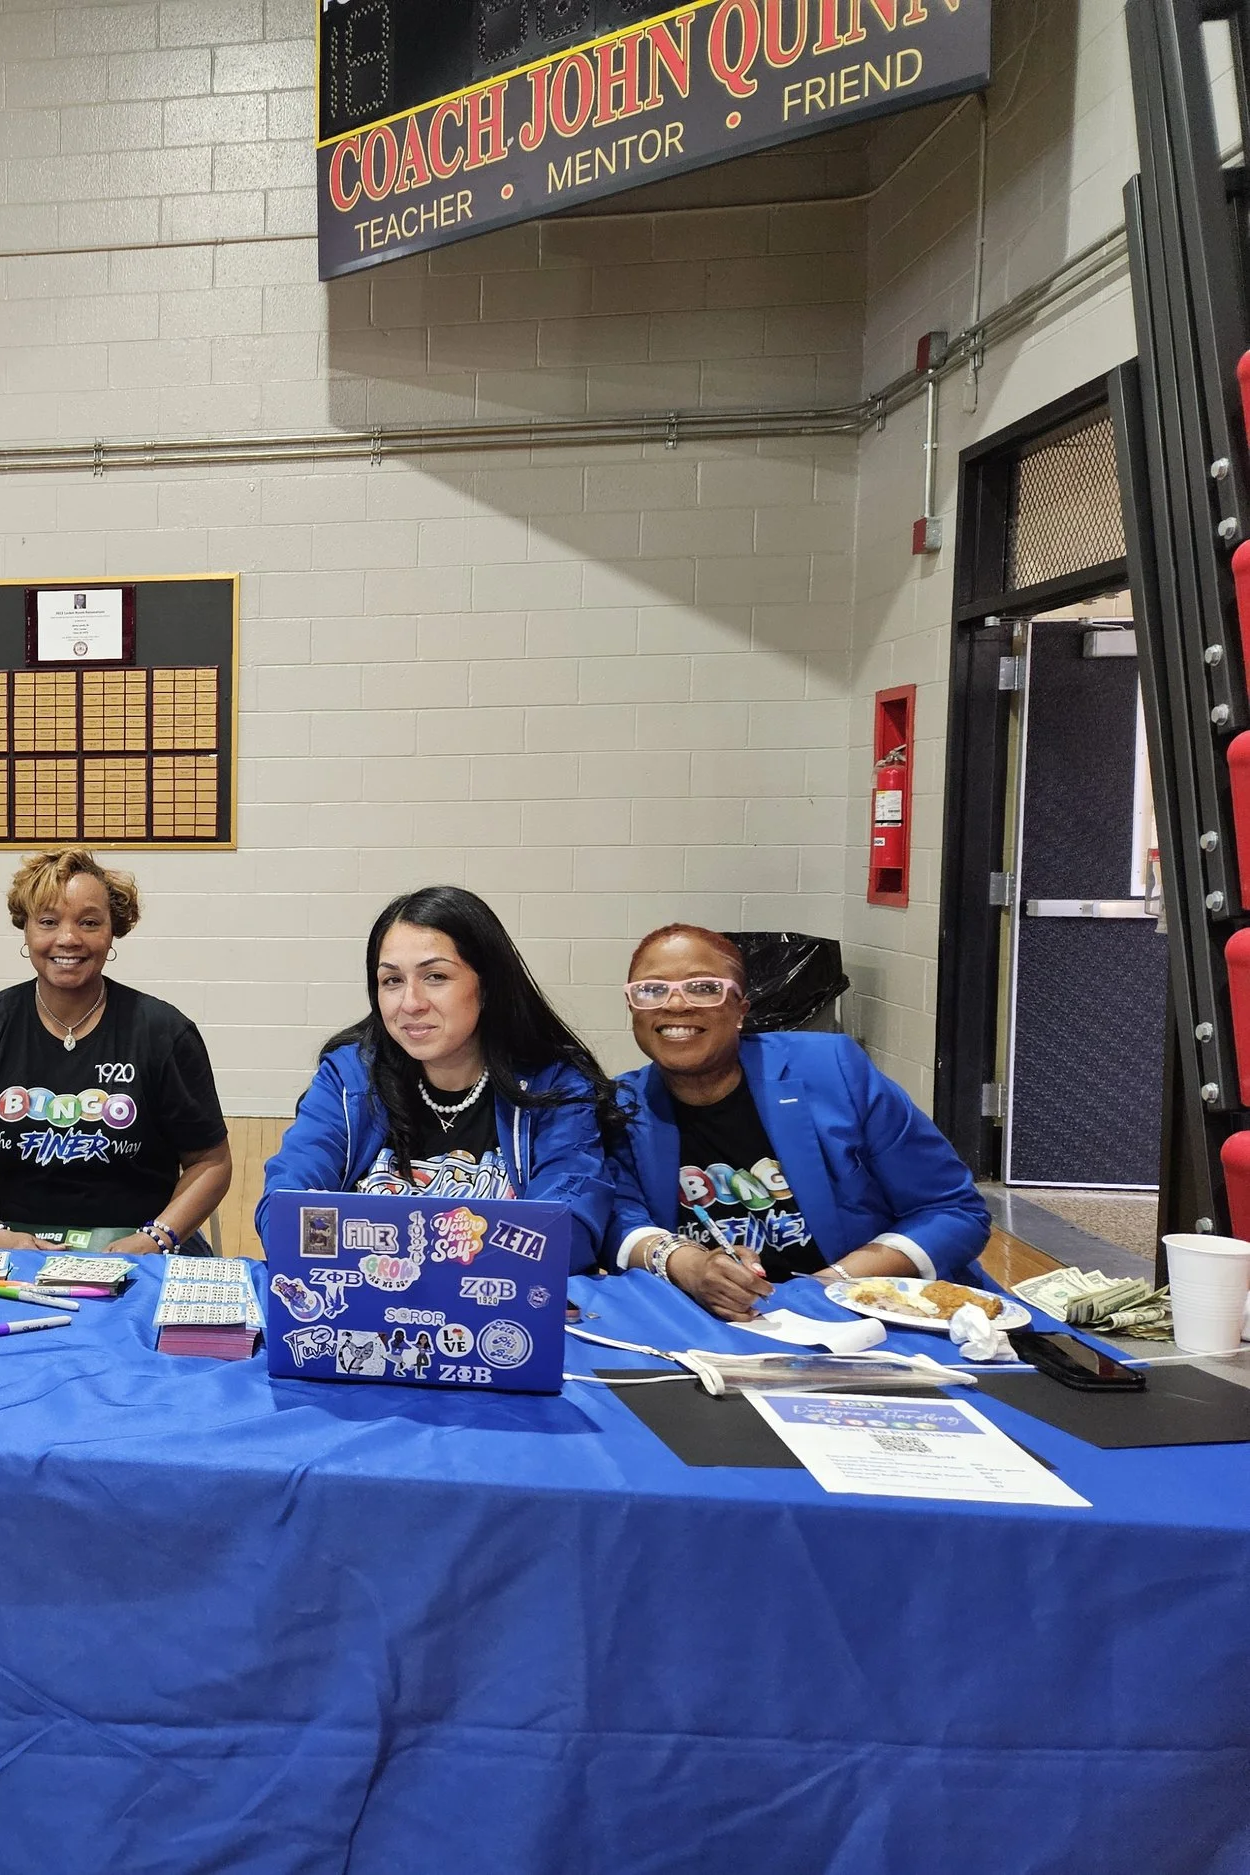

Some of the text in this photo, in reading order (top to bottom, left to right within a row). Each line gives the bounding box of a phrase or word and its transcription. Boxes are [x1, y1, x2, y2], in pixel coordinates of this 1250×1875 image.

[329, 80, 509, 212] COACH
[518, 11, 695, 152] JOHN
[355, 48, 923, 251] TEACHER MENTOR FRIEND
[95, 1062, 136, 1084] 1920
[0, 1089, 134, 1125] BINGO
[17, 1127, 110, 1166] FINER
[111, 1140, 142, 1159] Way
[345, 1221, 396, 1251] FINER
[434, 1217, 484, 1237] Your
[448, 1231, 474, 1242] best
[431, 1238, 479, 1263] Self
[491, 1222, 544, 1260] ZETA
[365, 1256, 414, 1280] GROW
[478, 1296, 498, 1305] 1920
